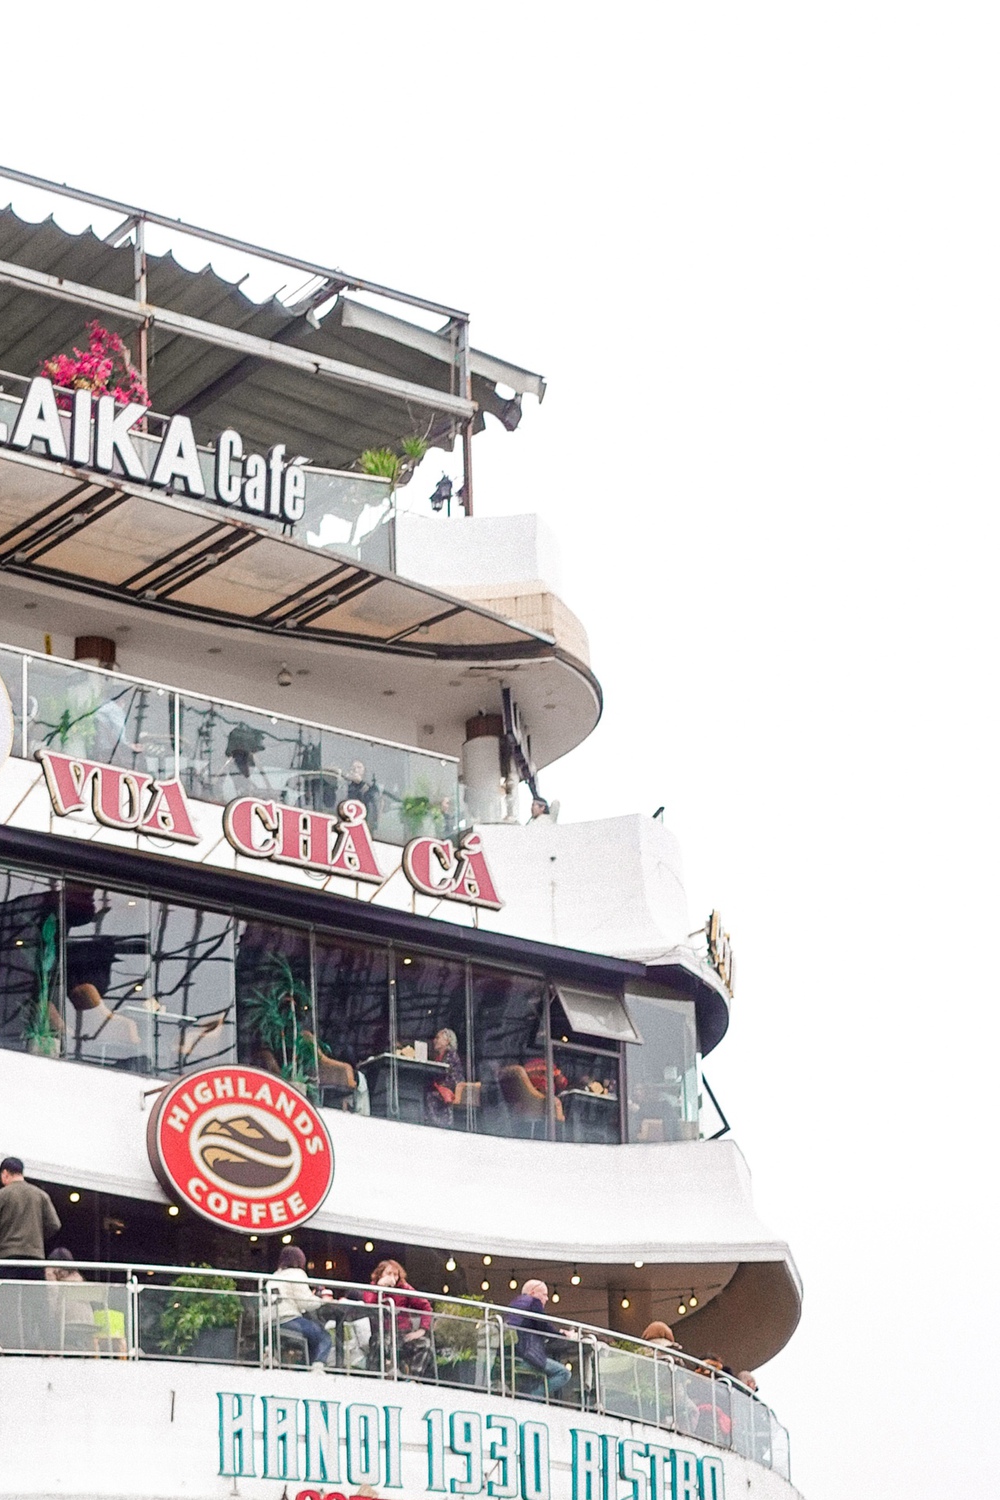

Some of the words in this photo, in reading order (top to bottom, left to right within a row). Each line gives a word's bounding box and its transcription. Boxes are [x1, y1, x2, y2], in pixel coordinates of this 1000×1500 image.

[215, 429, 306, 521] Café
[35, 749, 200, 844] VUA
[223, 797, 385, 883] CHẢ
[402, 831, 503, 911] CÁ
[167, 1076, 325, 1156] HIGHLANDS
[187, 1177, 308, 1225] COFFEE
[217, 1392, 402, 1487] HANOI
